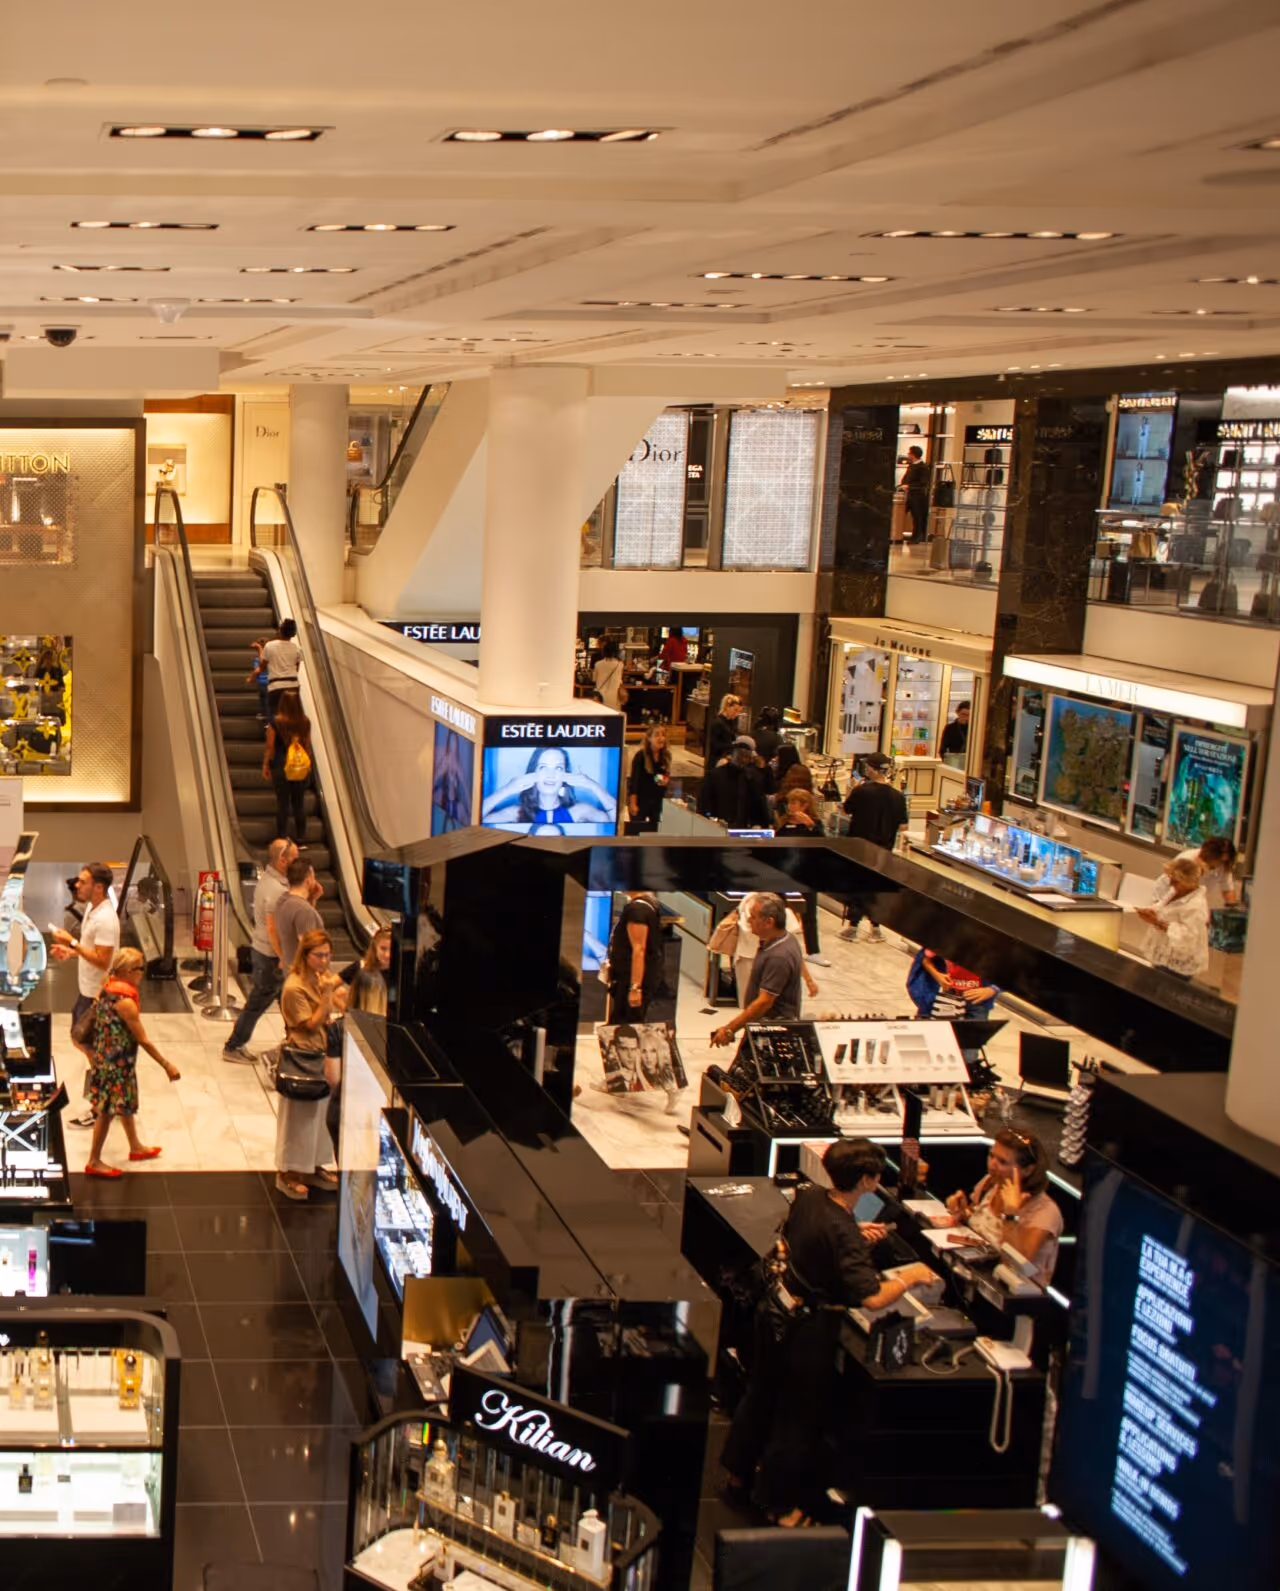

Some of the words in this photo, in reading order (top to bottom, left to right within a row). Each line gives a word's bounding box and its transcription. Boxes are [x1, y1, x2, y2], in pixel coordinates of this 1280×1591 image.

[255, 425, 280, 438] Dior
[547, 724, 607, 739] LAUDER
[474, 1389, 598, 1473] Kilian
